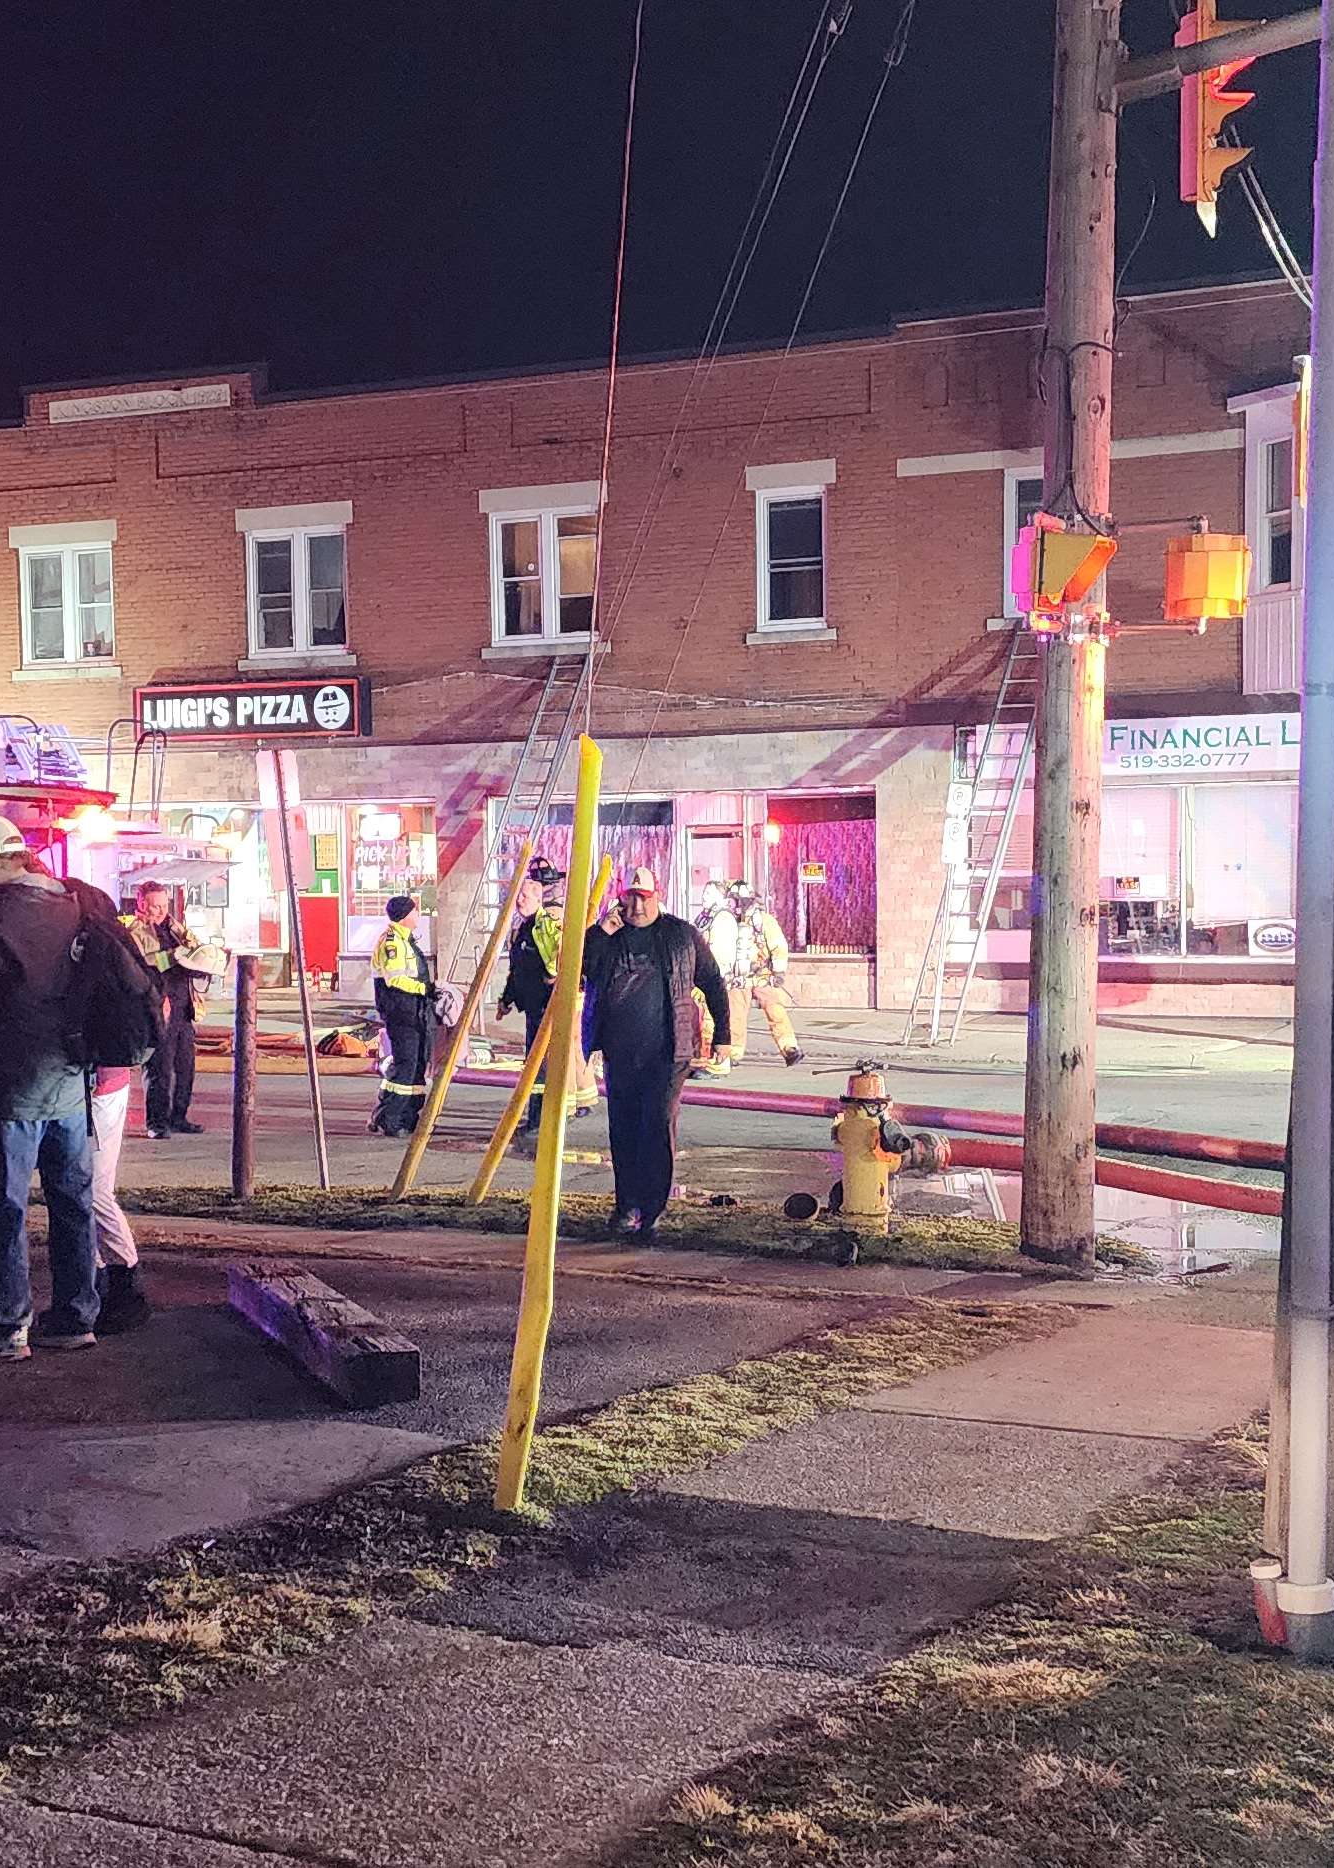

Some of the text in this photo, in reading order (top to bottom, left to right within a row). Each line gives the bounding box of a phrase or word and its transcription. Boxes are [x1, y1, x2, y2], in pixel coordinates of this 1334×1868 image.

[143, 694, 309, 730] LUIGI'S PIZZA
[1110, 725, 1272, 751] FINANCIAL
[1119, 752, 1251, 769] 519-332-0777
[631, 873, 641, 885] A
